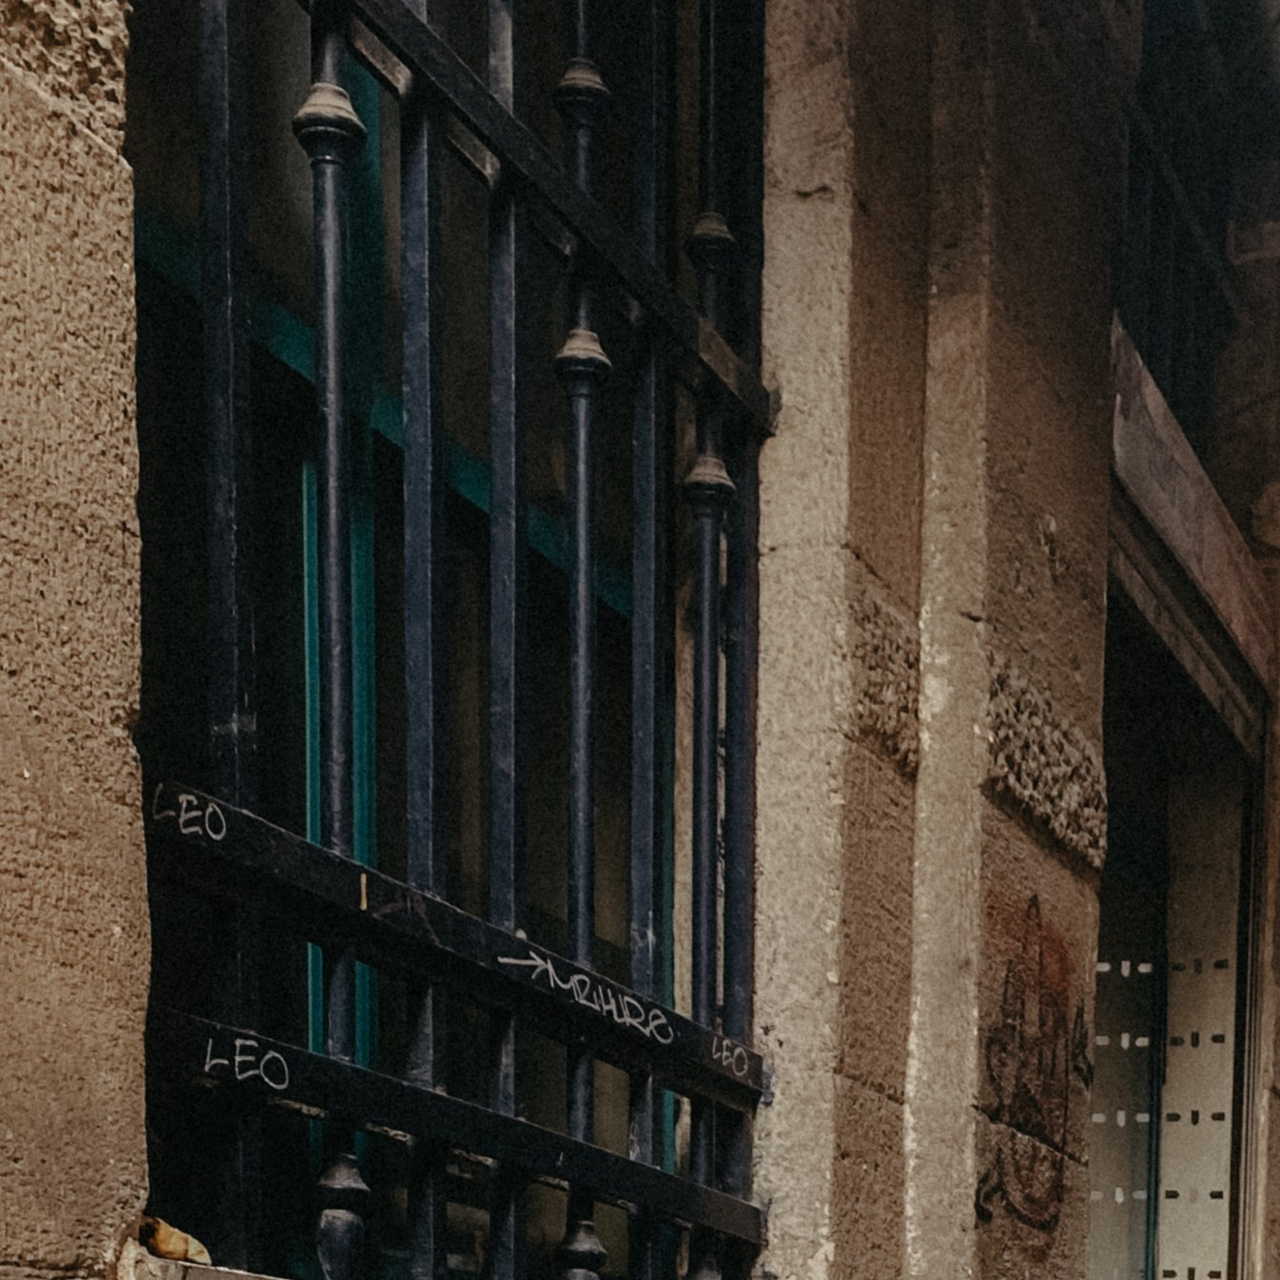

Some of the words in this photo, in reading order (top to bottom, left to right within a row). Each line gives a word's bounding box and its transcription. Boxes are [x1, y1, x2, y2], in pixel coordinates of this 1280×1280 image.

[153, 783, 226, 841] LEO
[204, 1038, 289, 1090] LEO
[711, 1036, 749, 1077] LEO
